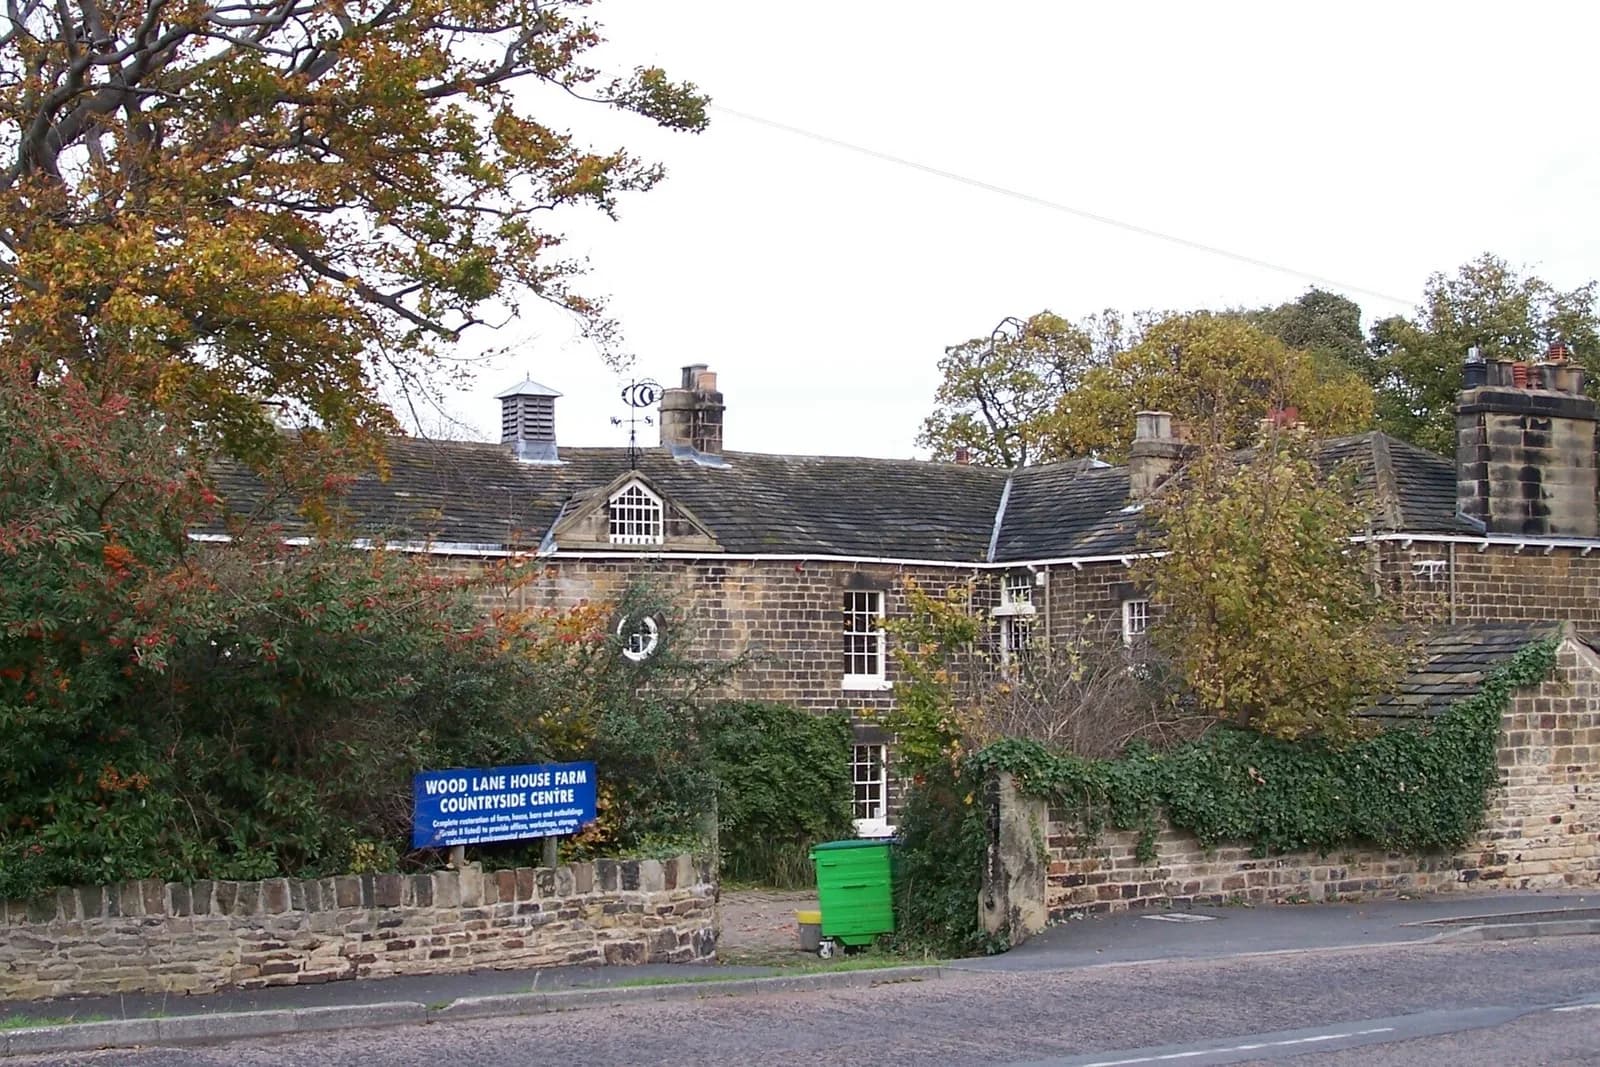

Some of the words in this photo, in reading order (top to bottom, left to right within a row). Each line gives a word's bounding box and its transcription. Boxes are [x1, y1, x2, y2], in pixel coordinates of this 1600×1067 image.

[426, 779, 467, 794] WOOD
[473, 776, 505, 791] LANE
[511, 773, 550, 788] HOUSE
[555, 770, 587, 785] FARM
[440, 793, 526, 812] COUNTRYSIDE
[531, 789, 574, 806] CENTRE
[432, 819, 458, 828] Complete
[459, 816, 489, 824] restoration
[490, 814, 496, 822] of
[554, 808, 583, 816] outbuildings
[469, 836, 479, 844] and
[519, 830, 543, 839] education
[489, 824, 508, 834] provide
